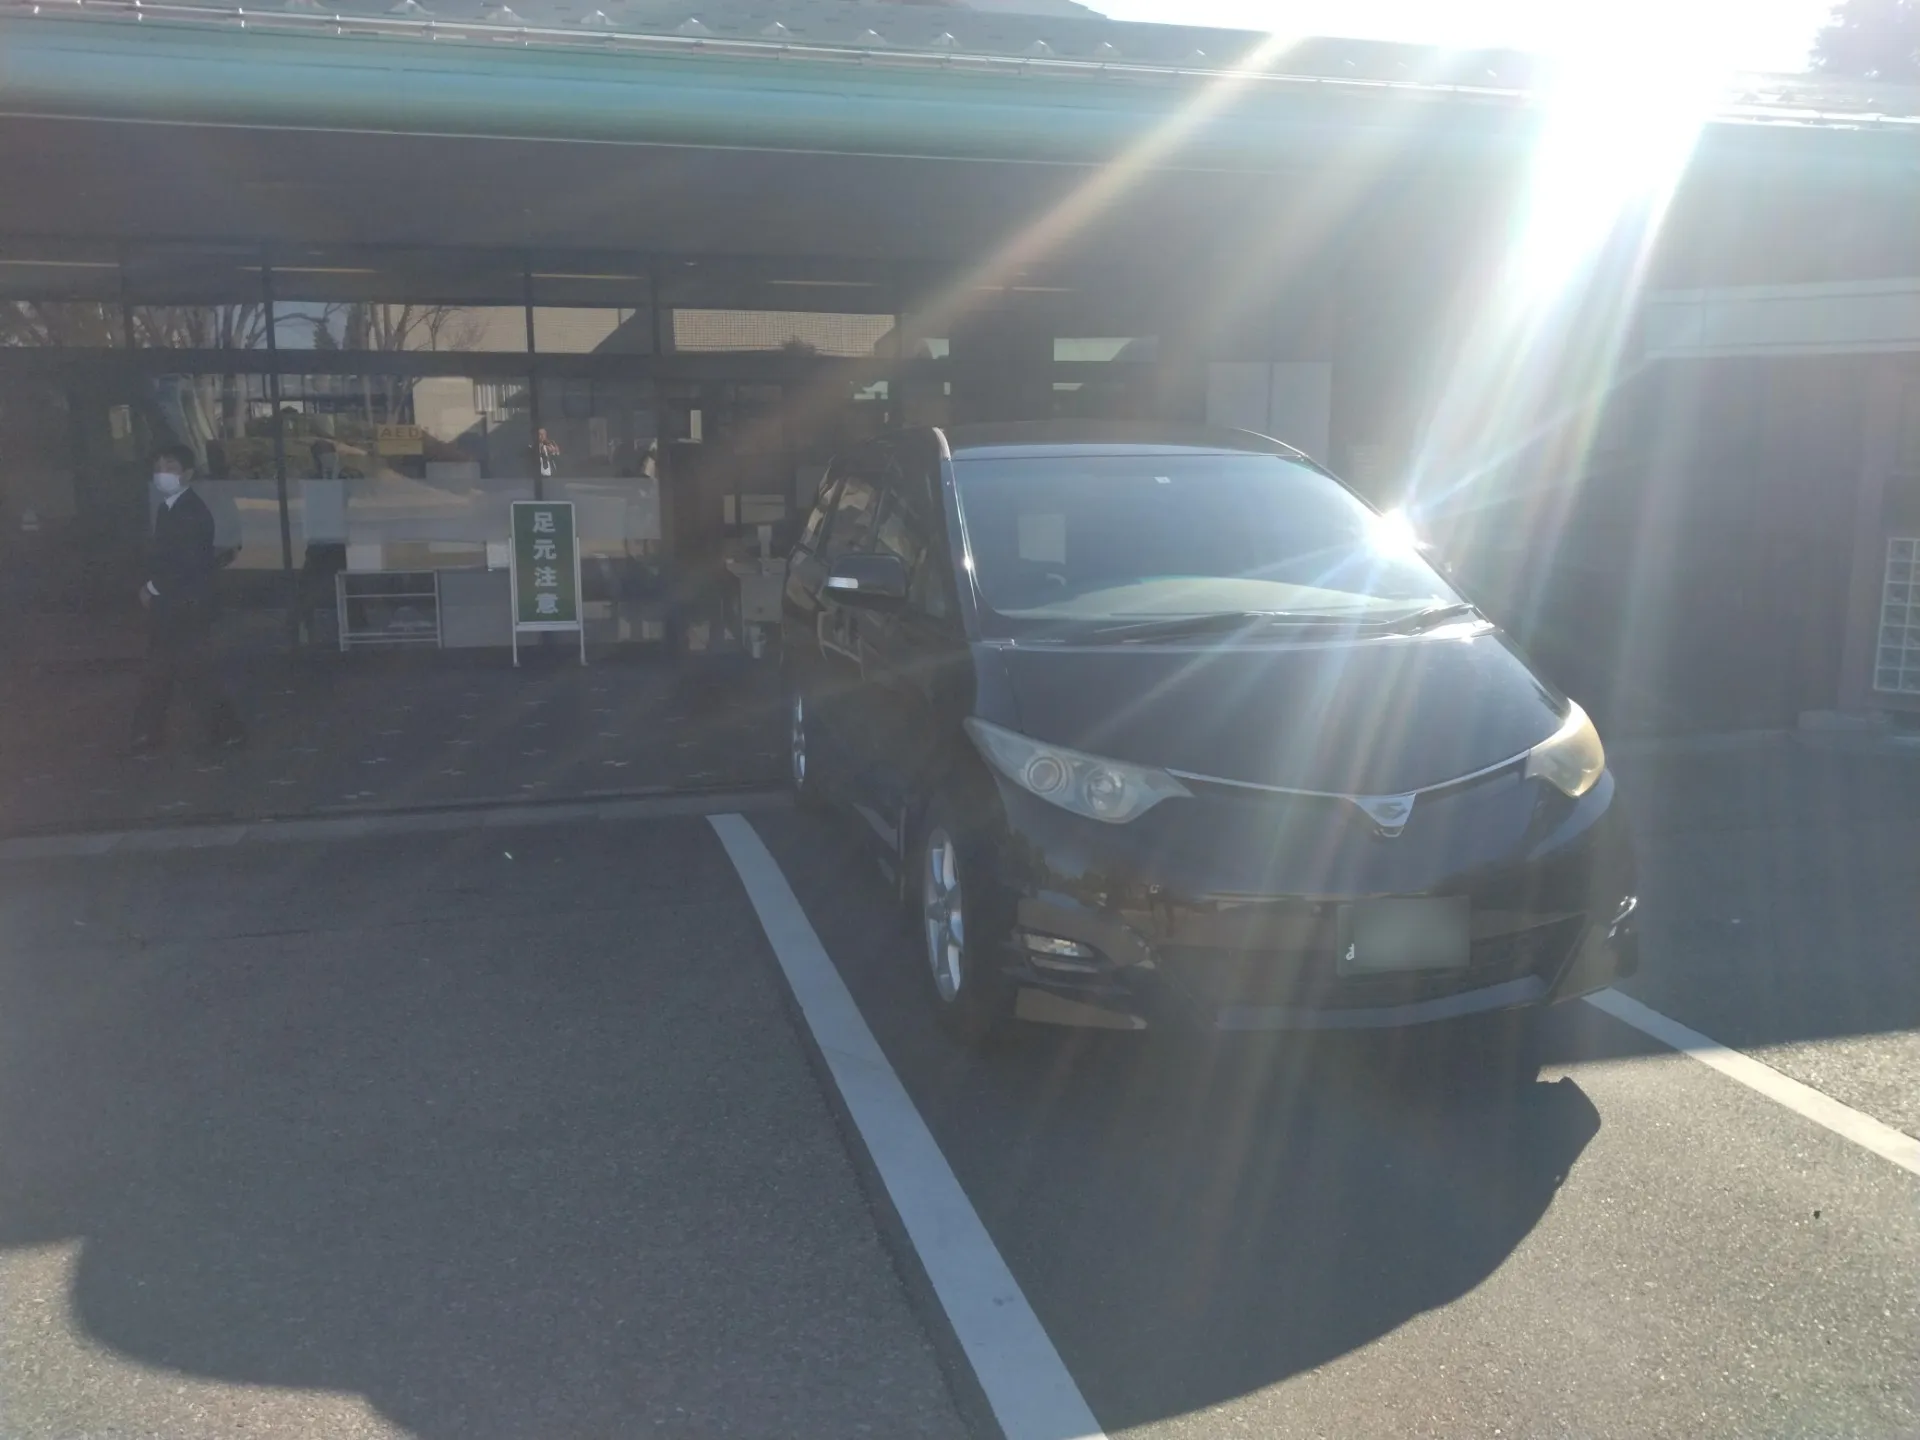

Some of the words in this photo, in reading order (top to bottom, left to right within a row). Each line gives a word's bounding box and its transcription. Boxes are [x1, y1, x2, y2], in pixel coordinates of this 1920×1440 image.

[380, 426, 420, 439] AED
[532, 511, 559, 614] 足元注意
